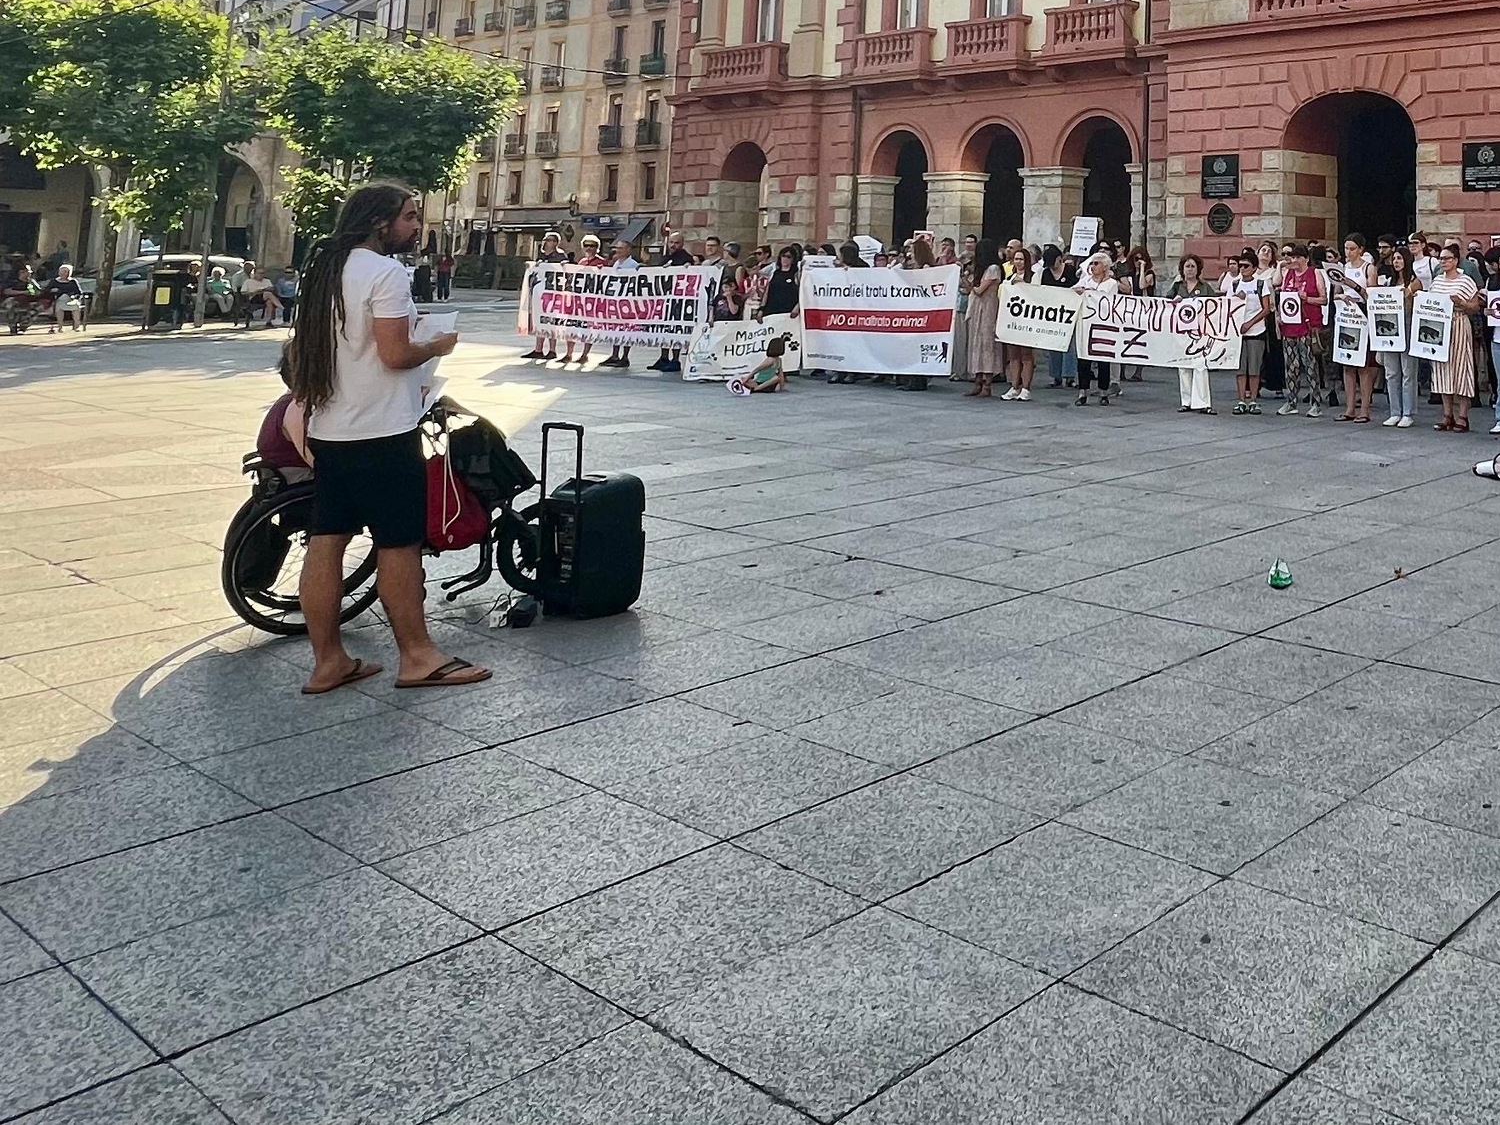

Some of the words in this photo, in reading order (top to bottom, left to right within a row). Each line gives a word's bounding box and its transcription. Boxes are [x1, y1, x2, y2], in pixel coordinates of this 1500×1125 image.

[813, 283, 865, 298] Animaliei
[866, 284, 887, 298] tratu
[890, 284, 930, 298] txarrik
[541, 292, 665, 320] TAUROMAQUIA
[847, 315, 857, 326] al
[858, 316, 891, 327] maltrato
[735, 326, 775, 342] Marcan
[1088, 323, 1150, 360] EZ
